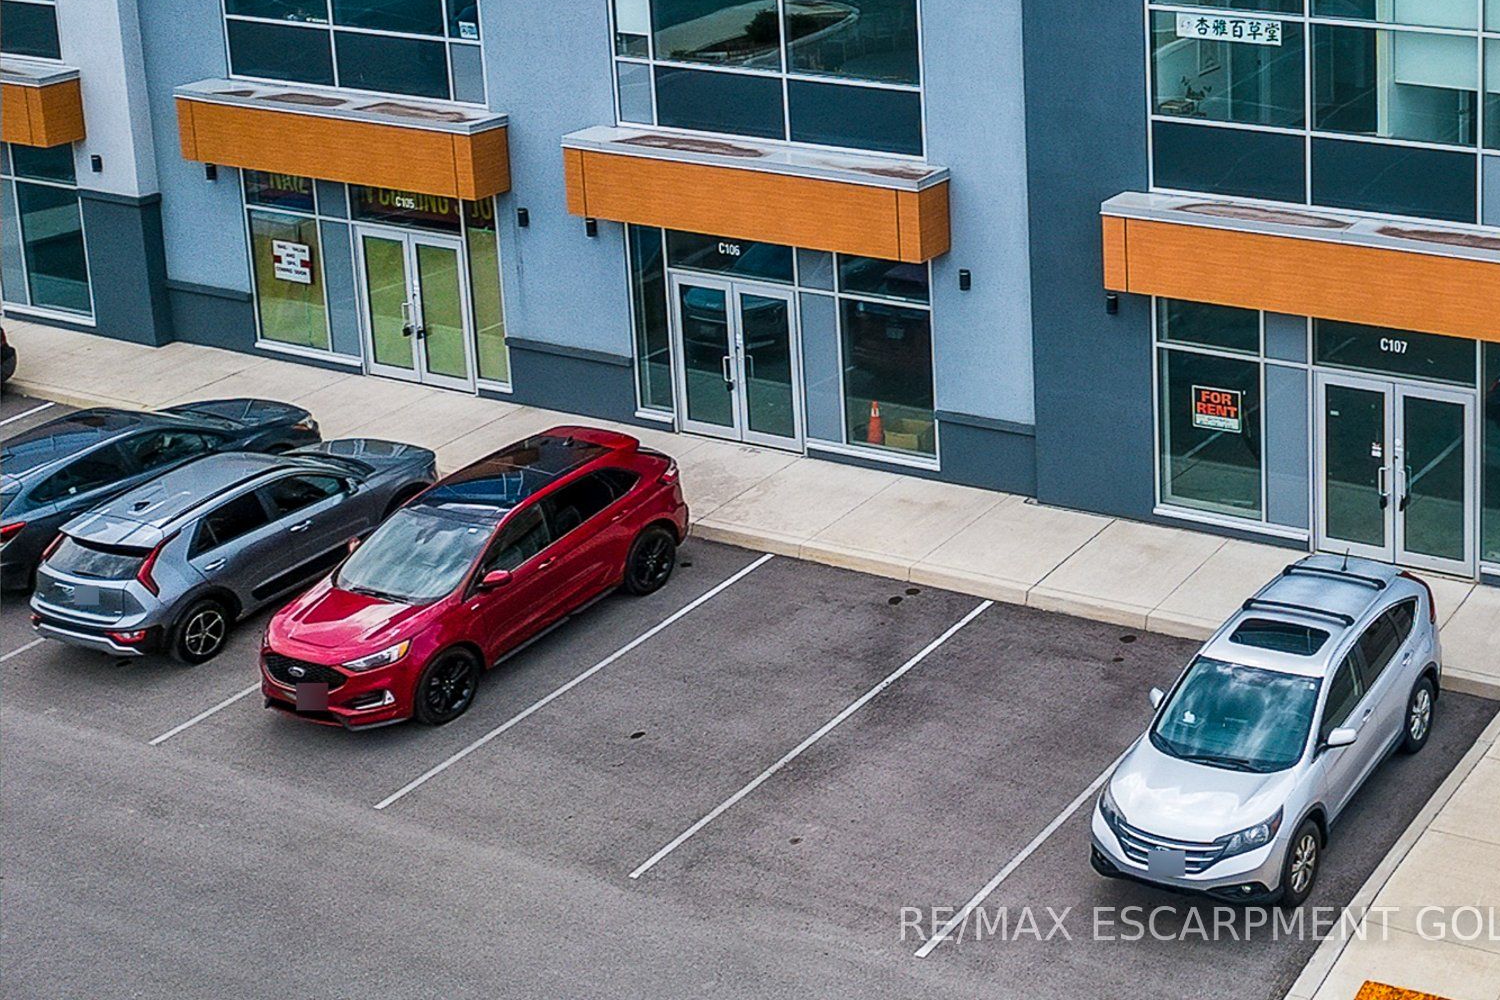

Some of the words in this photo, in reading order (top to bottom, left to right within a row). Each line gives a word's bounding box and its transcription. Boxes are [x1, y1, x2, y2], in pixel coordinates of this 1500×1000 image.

[1195, 17, 1280, 42] 杏雅百草堂
[395, 196, 415, 209] C105
[1380, 338, 1407, 354] C107
[1201, 390, 1232, 406] FOR
[1196, 401, 1238, 418] RENT
